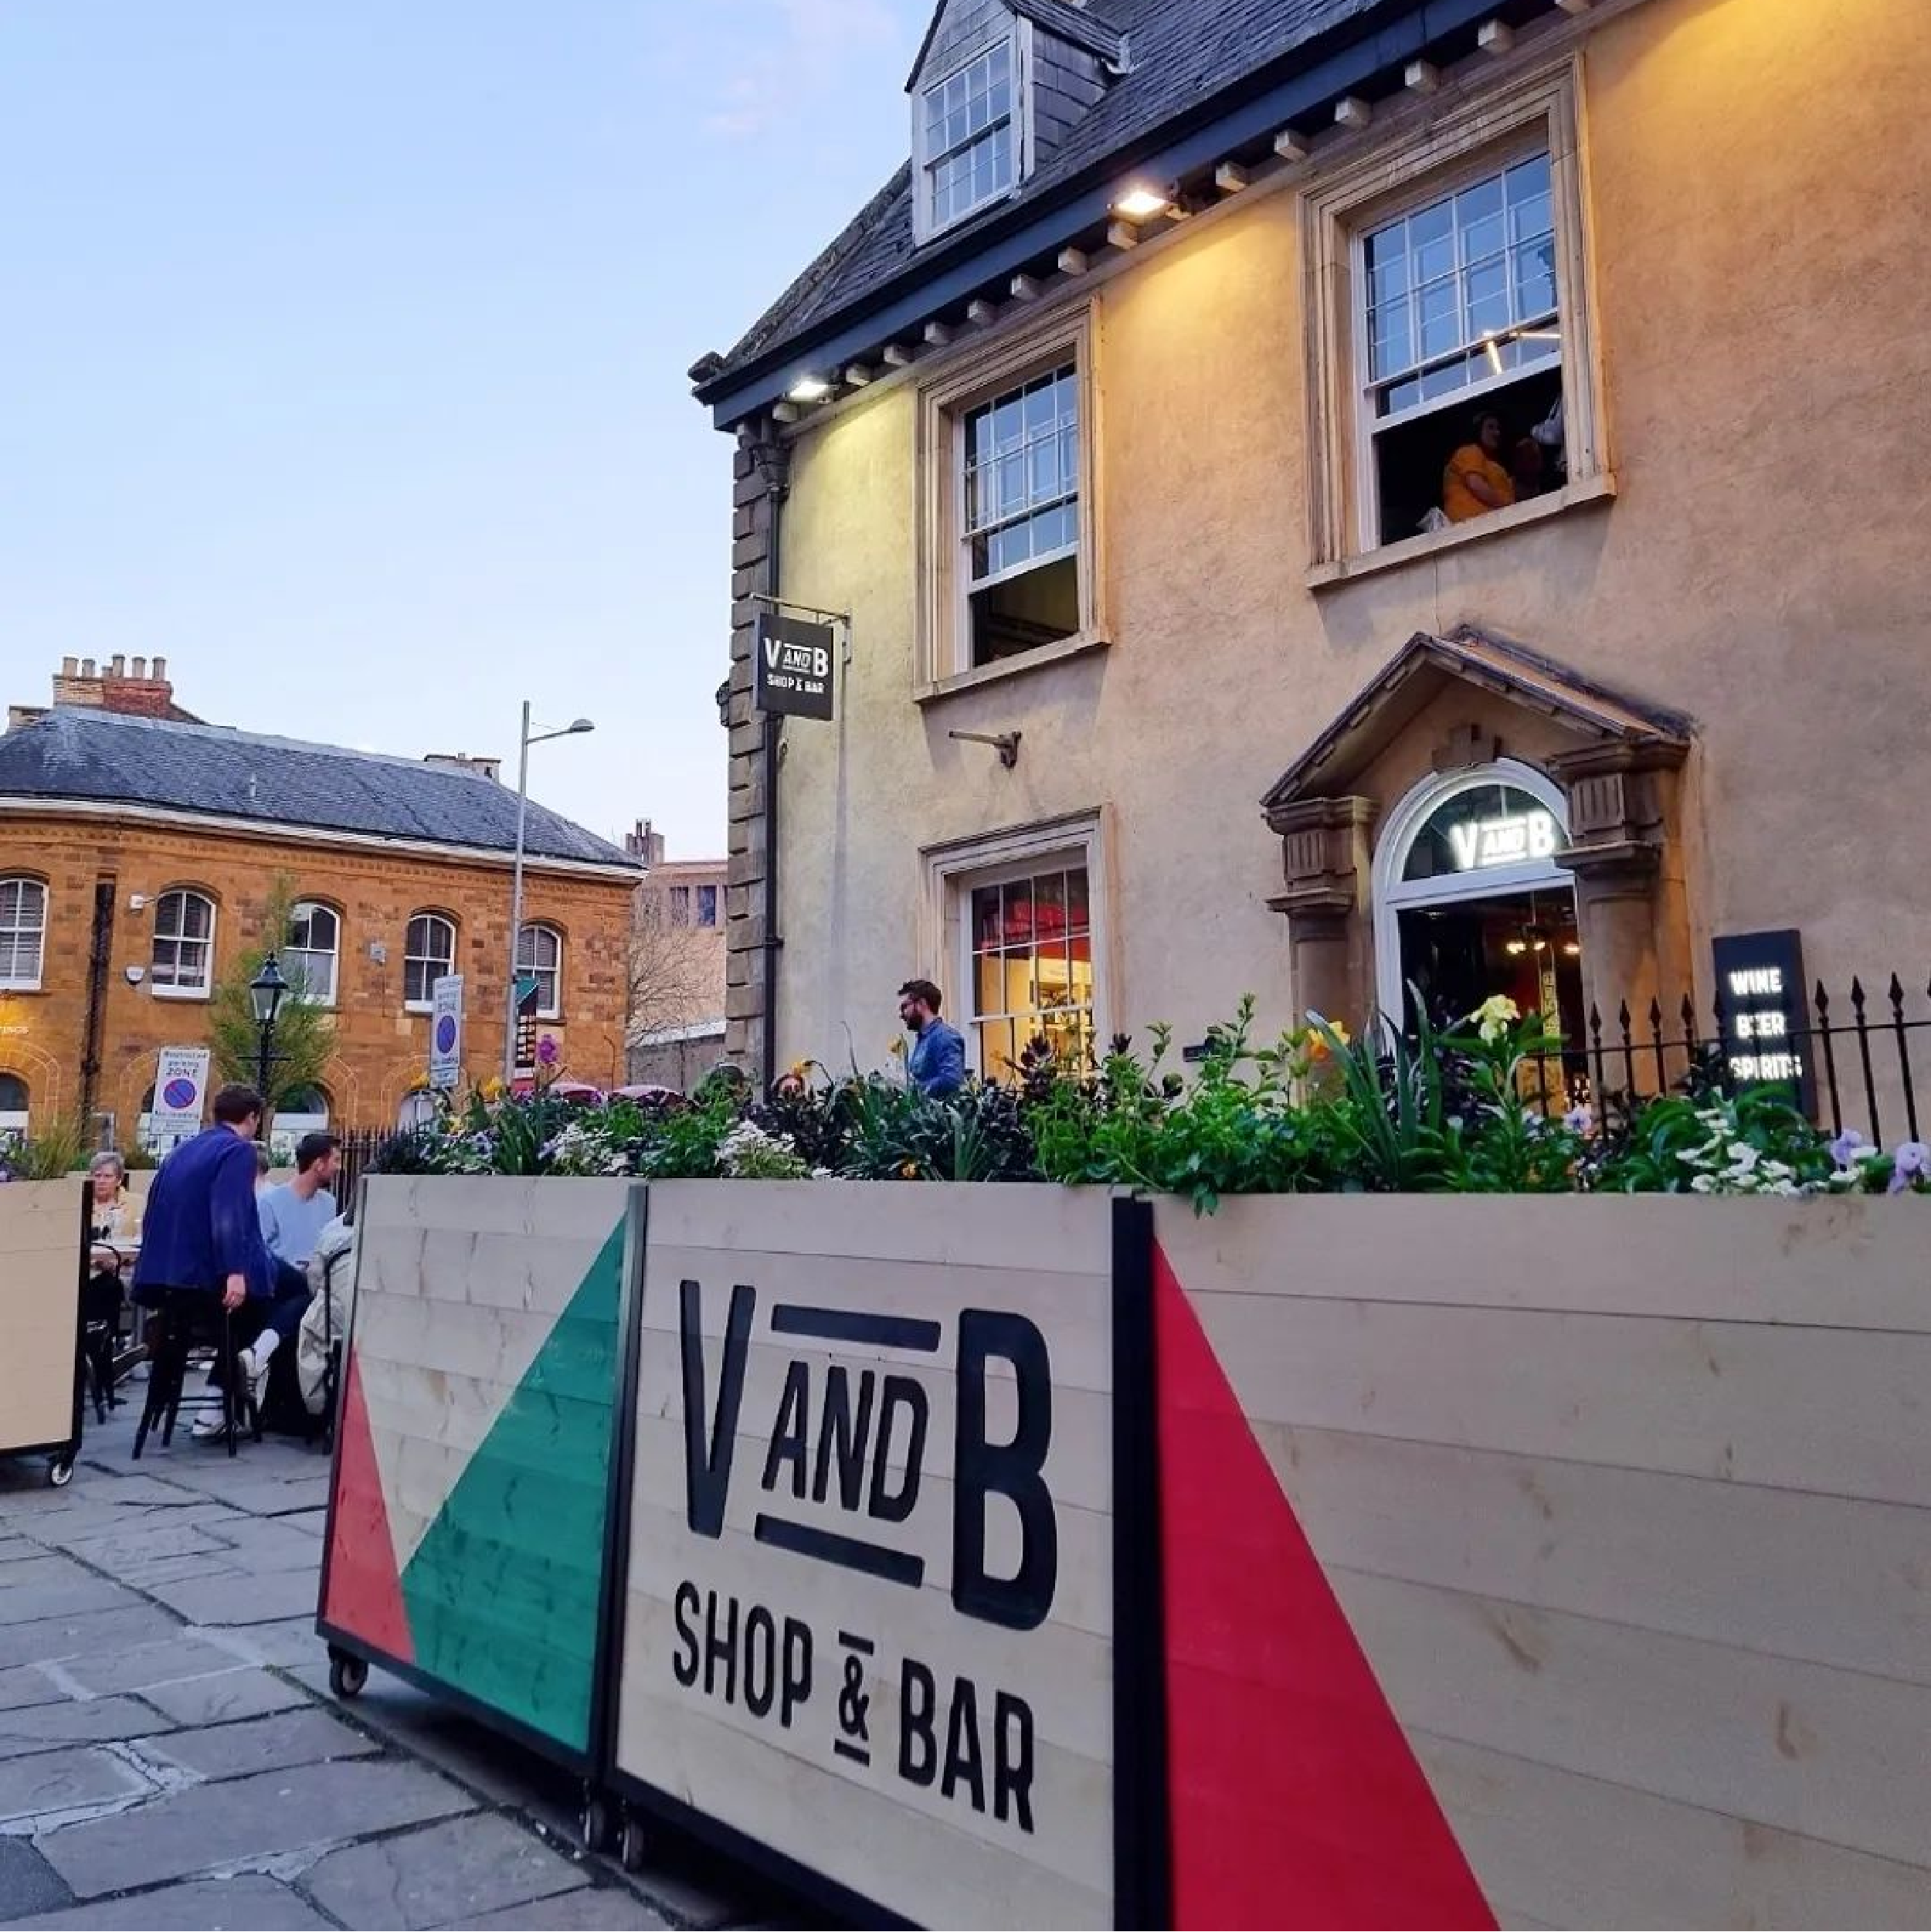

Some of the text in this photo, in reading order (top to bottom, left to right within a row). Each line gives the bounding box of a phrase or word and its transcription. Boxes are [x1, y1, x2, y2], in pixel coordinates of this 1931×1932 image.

[763, 637, 782, 668] V
[813, 647, 829, 677] B
[1451, 820, 1478, 870] V
[1529, 811, 1555, 857] B
[1729, 967, 1783, 996] WINE
[1736, 1011, 1786, 1038] BEER
[680, 1279, 1057, 1632] V AND B
[674, 1581, 1033, 1834] SHOP & BAR
